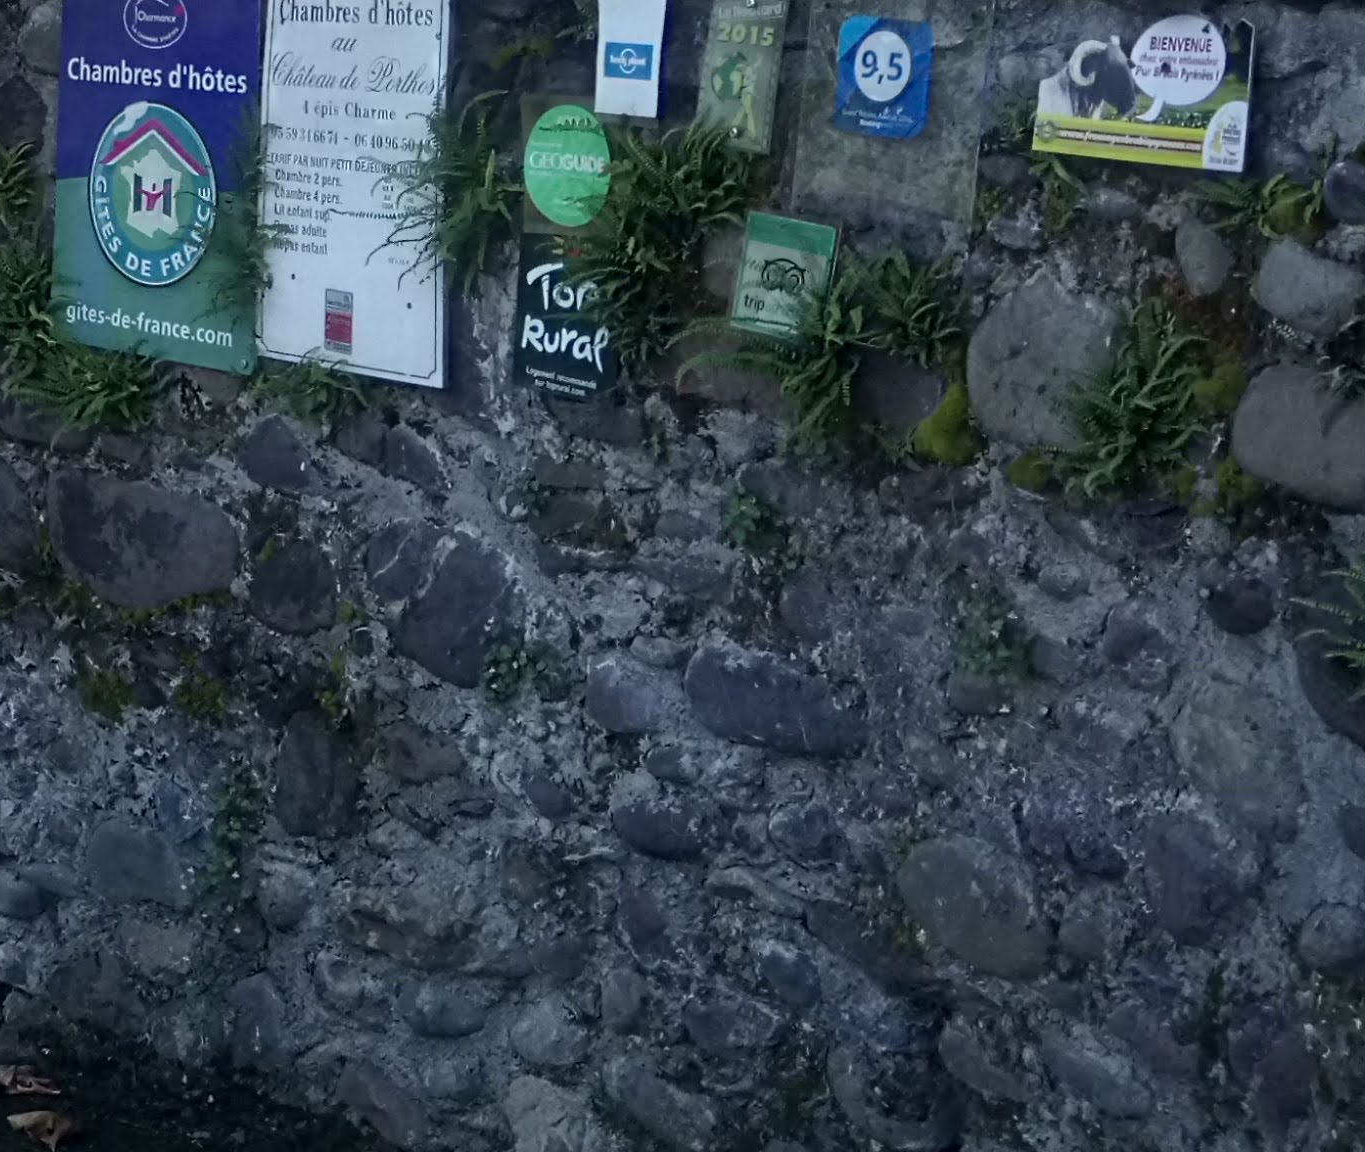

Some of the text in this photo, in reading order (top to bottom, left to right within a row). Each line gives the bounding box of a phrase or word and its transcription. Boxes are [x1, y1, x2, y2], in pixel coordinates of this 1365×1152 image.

[716, 21, 775, 47] 2015
[330, 36, 357, 52] au
[1150, 35, 1212, 53] BIENVENUE
[67, 56, 248, 94] Chambres d'hôtes
[271, 50, 436, 96] Château de Porthos
[861, 49, 904, 85] 9,5
[314, 100, 339, 118] épis
[344, 101, 397, 121] Charme
[275, 169, 312, 184] Chambre
[314, 172, 320, 185] 2
[274, 186, 312, 201] Chambre
[313, 190, 319, 202] 4
[287, 205, 313, 219] enfant
[301, 224, 327, 238] adulte
[301, 242, 328, 255] enfant
[125, 251, 152, 277] DE
[744, 294, 765, 312] trip
[66, 301, 233, 348] gites-de-france.com
[521, 314, 610, 374] Rural
